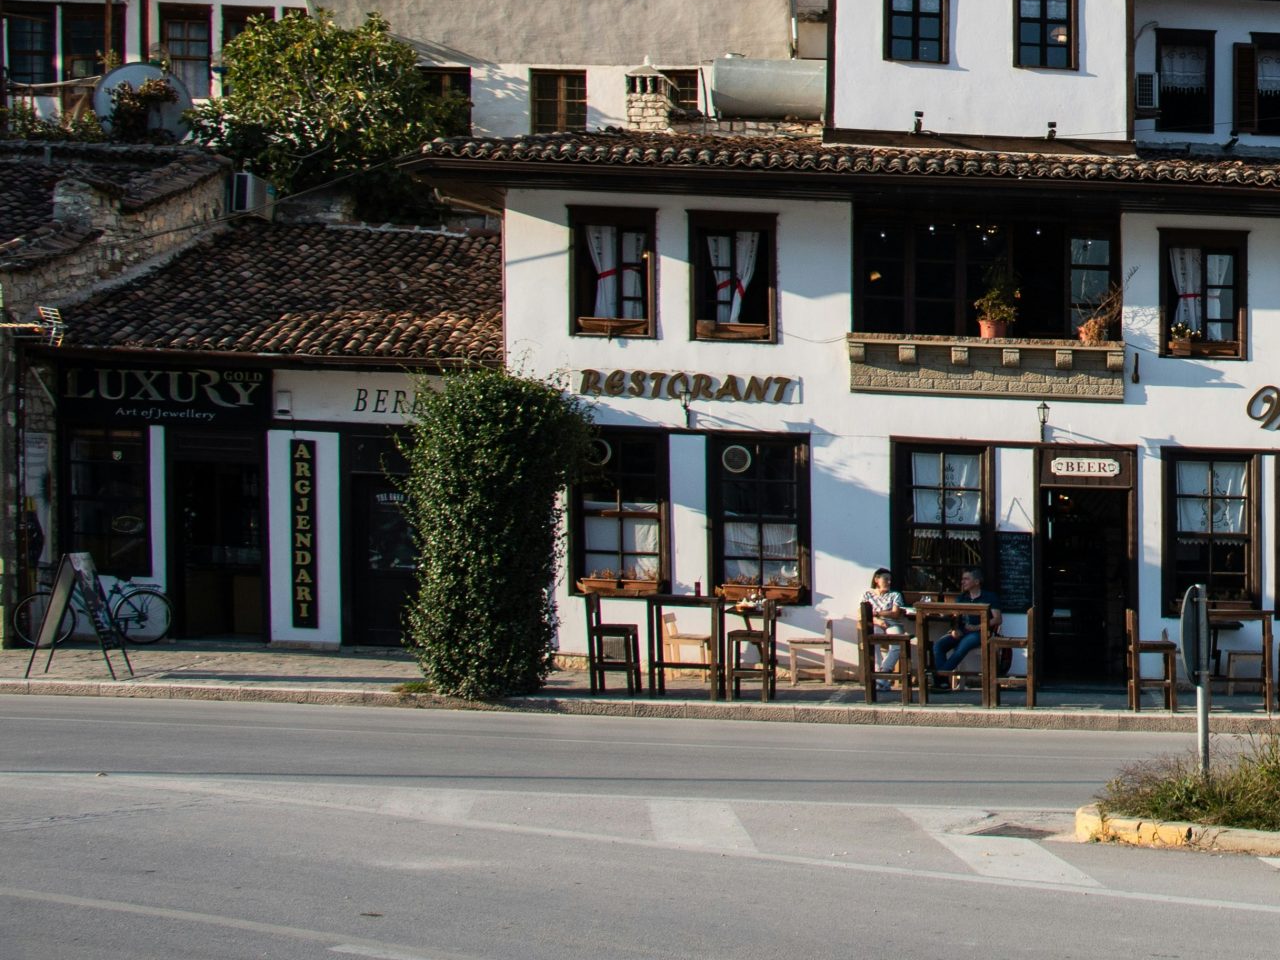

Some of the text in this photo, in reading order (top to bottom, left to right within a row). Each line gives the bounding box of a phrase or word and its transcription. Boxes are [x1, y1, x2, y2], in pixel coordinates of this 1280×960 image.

[64, 368, 260, 408] LUXURY
[223, 371, 263, 382] GOLD
[581, 369, 791, 402] RESTORANT
[115, 407, 216, 422] Art of Jewellery
[1065, 461, 1108, 473] BEER
[294, 443, 313, 617] ARGJENDARI
